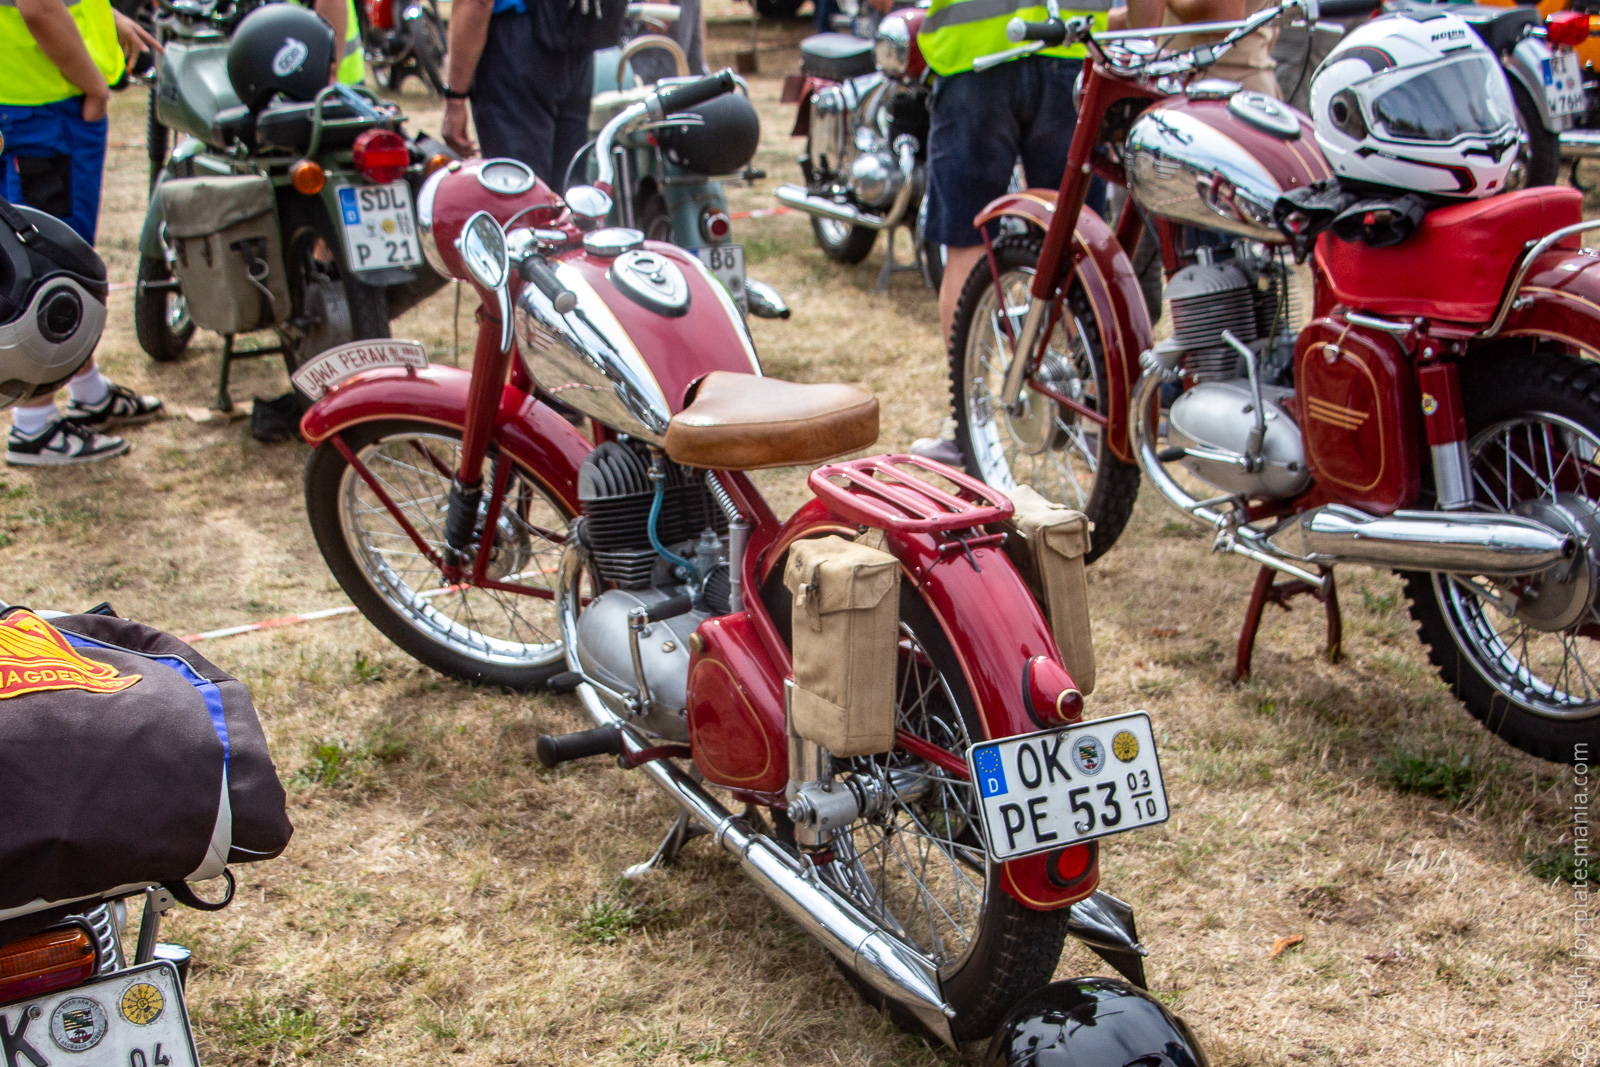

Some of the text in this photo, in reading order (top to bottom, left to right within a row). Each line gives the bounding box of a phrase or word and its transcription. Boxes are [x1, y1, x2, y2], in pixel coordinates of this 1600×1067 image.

[360, 187, 406, 211] SDL
[356, 240, 414, 265] P 21
[305, 346, 390, 390] JAWA PERAK
[1017, 737, 1072, 790] OK
[987, 777, 999, 793] D
[1127, 769, 1150, 791] 03
[999, 781, 1122, 850] PE 53
[1134, 797, 1157, 820] 10
